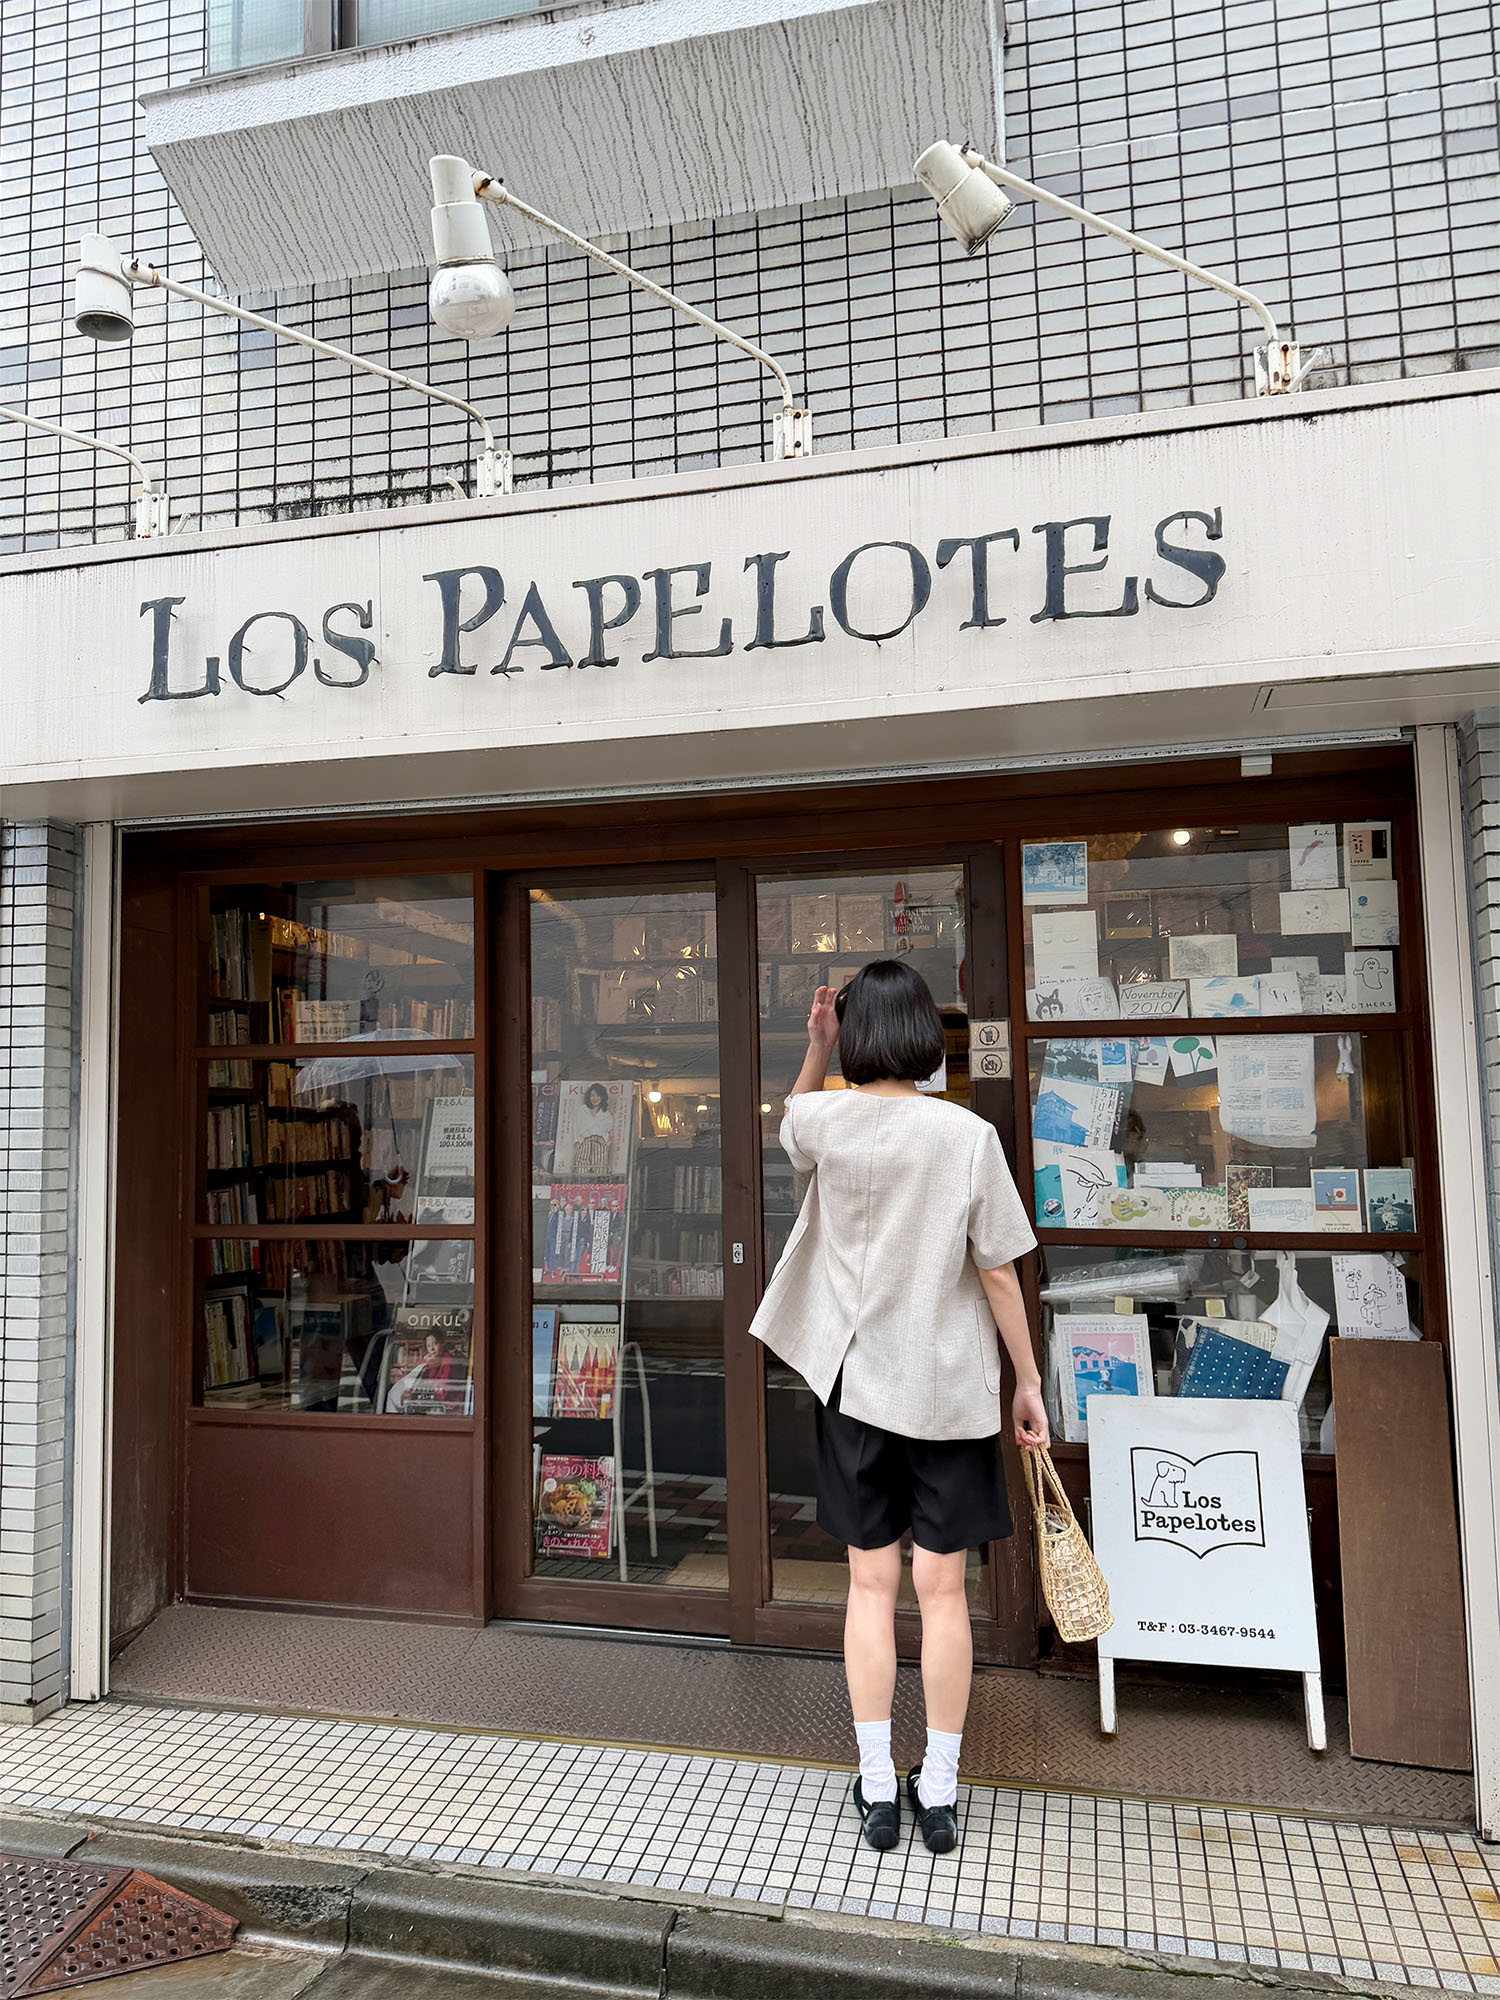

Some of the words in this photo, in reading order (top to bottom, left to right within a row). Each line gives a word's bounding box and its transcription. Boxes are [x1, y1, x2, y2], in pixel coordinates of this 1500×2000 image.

[1121, 988, 1179, 1000] November
[1130, 1002, 1173, 1014] 2010
[1351, 1001, 1393, 1010] OTHERS
[1182, 1491, 1222, 1509] Los
[1141, 1510, 1257, 1534] Papelotes
[1137, 1621, 1168, 1633] T&F
[1178, 1623, 1276, 1640] 03-3467-9544
